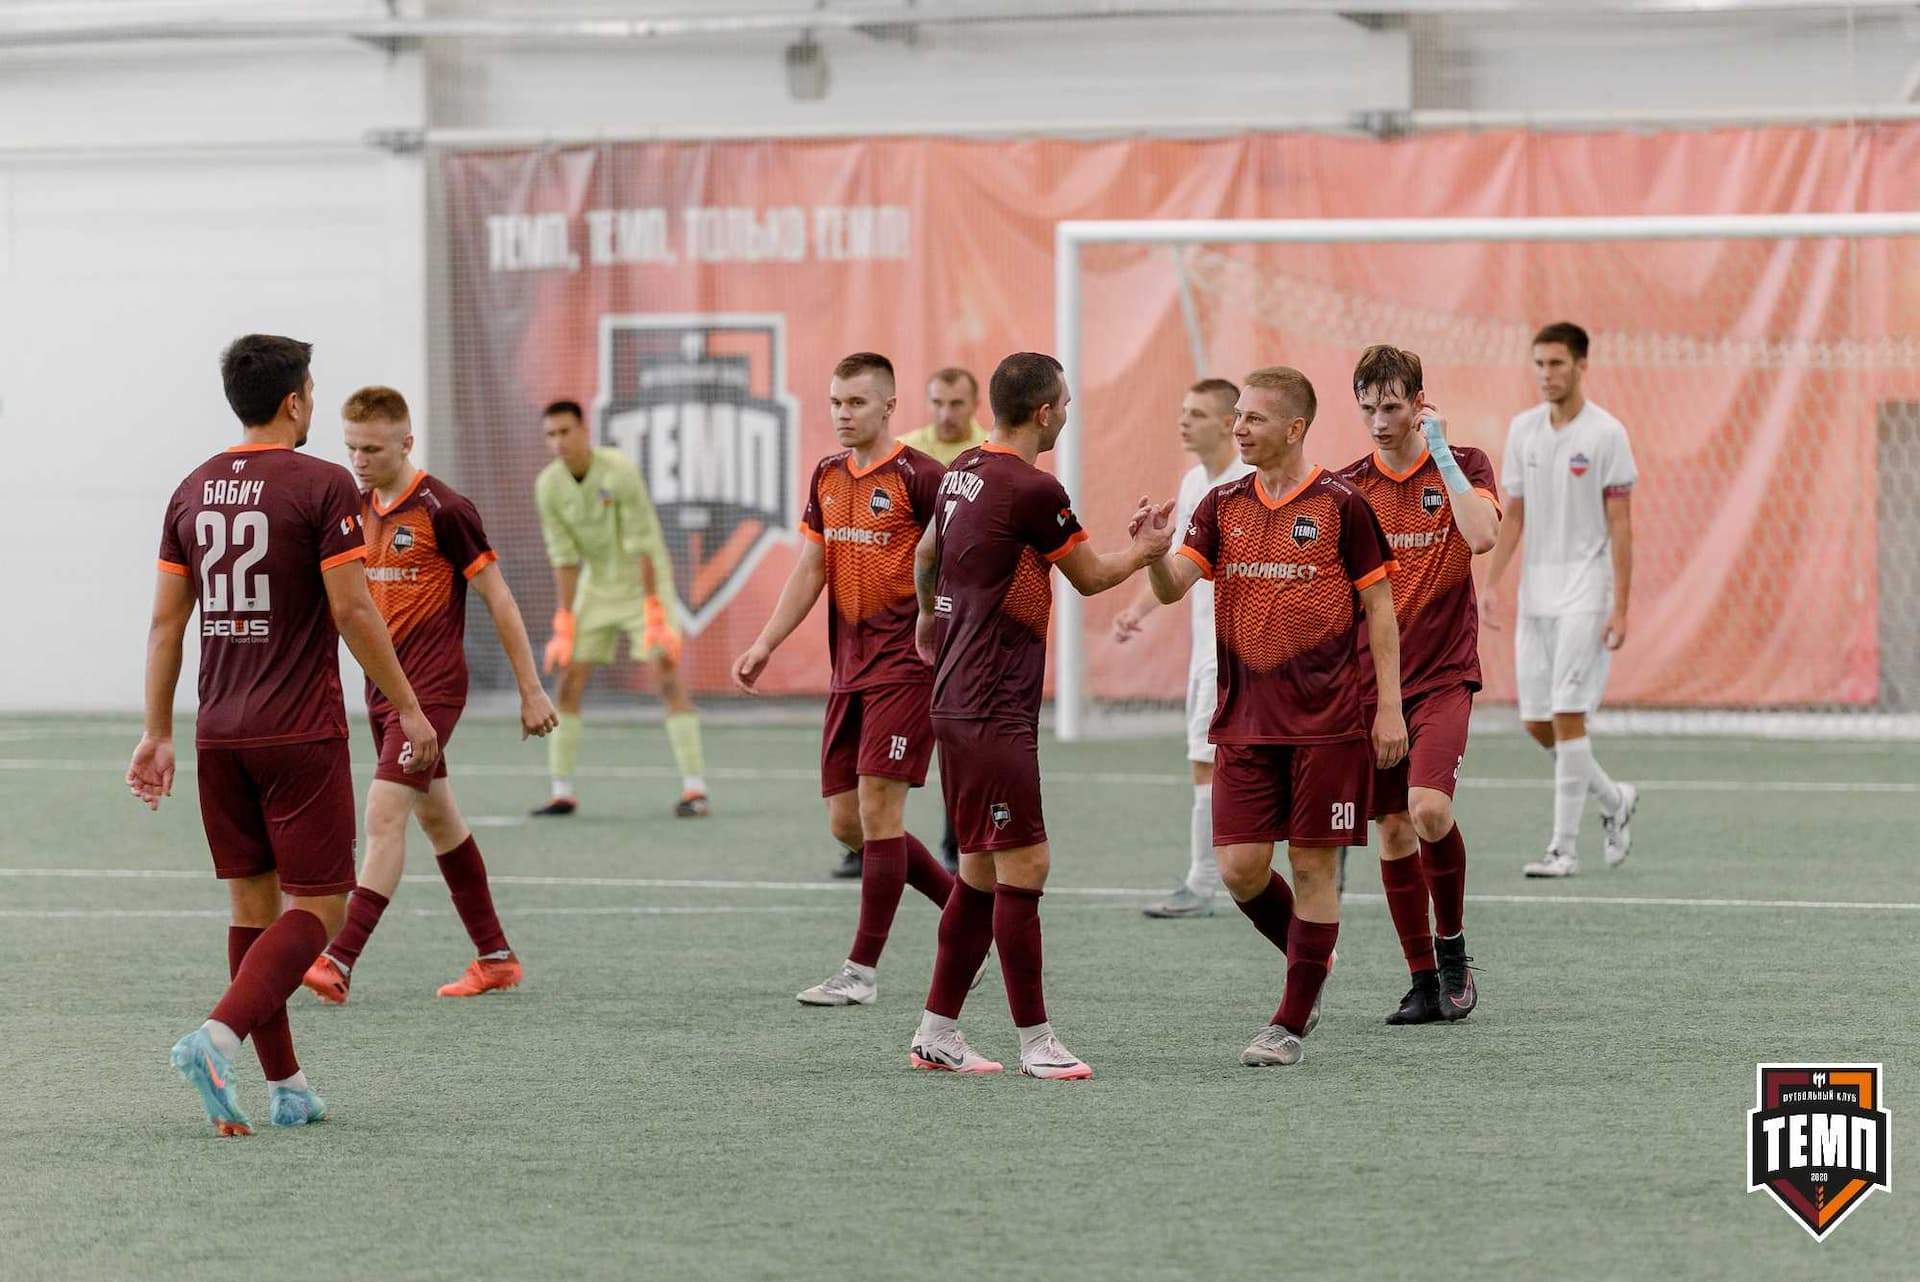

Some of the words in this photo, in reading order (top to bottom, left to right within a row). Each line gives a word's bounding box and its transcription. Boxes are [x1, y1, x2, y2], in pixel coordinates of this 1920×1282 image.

[609, 401, 778, 512] ТЕМП
[202, 479, 265, 506] БАБИЧ
[1294, 526, 1316, 539] ТЕМП
[195, 510, 271, 612] 22
[202, 619, 270, 637] SEUS
[888, 735, 908, 761] 15
[1331, 802, 1355, 831] 20
